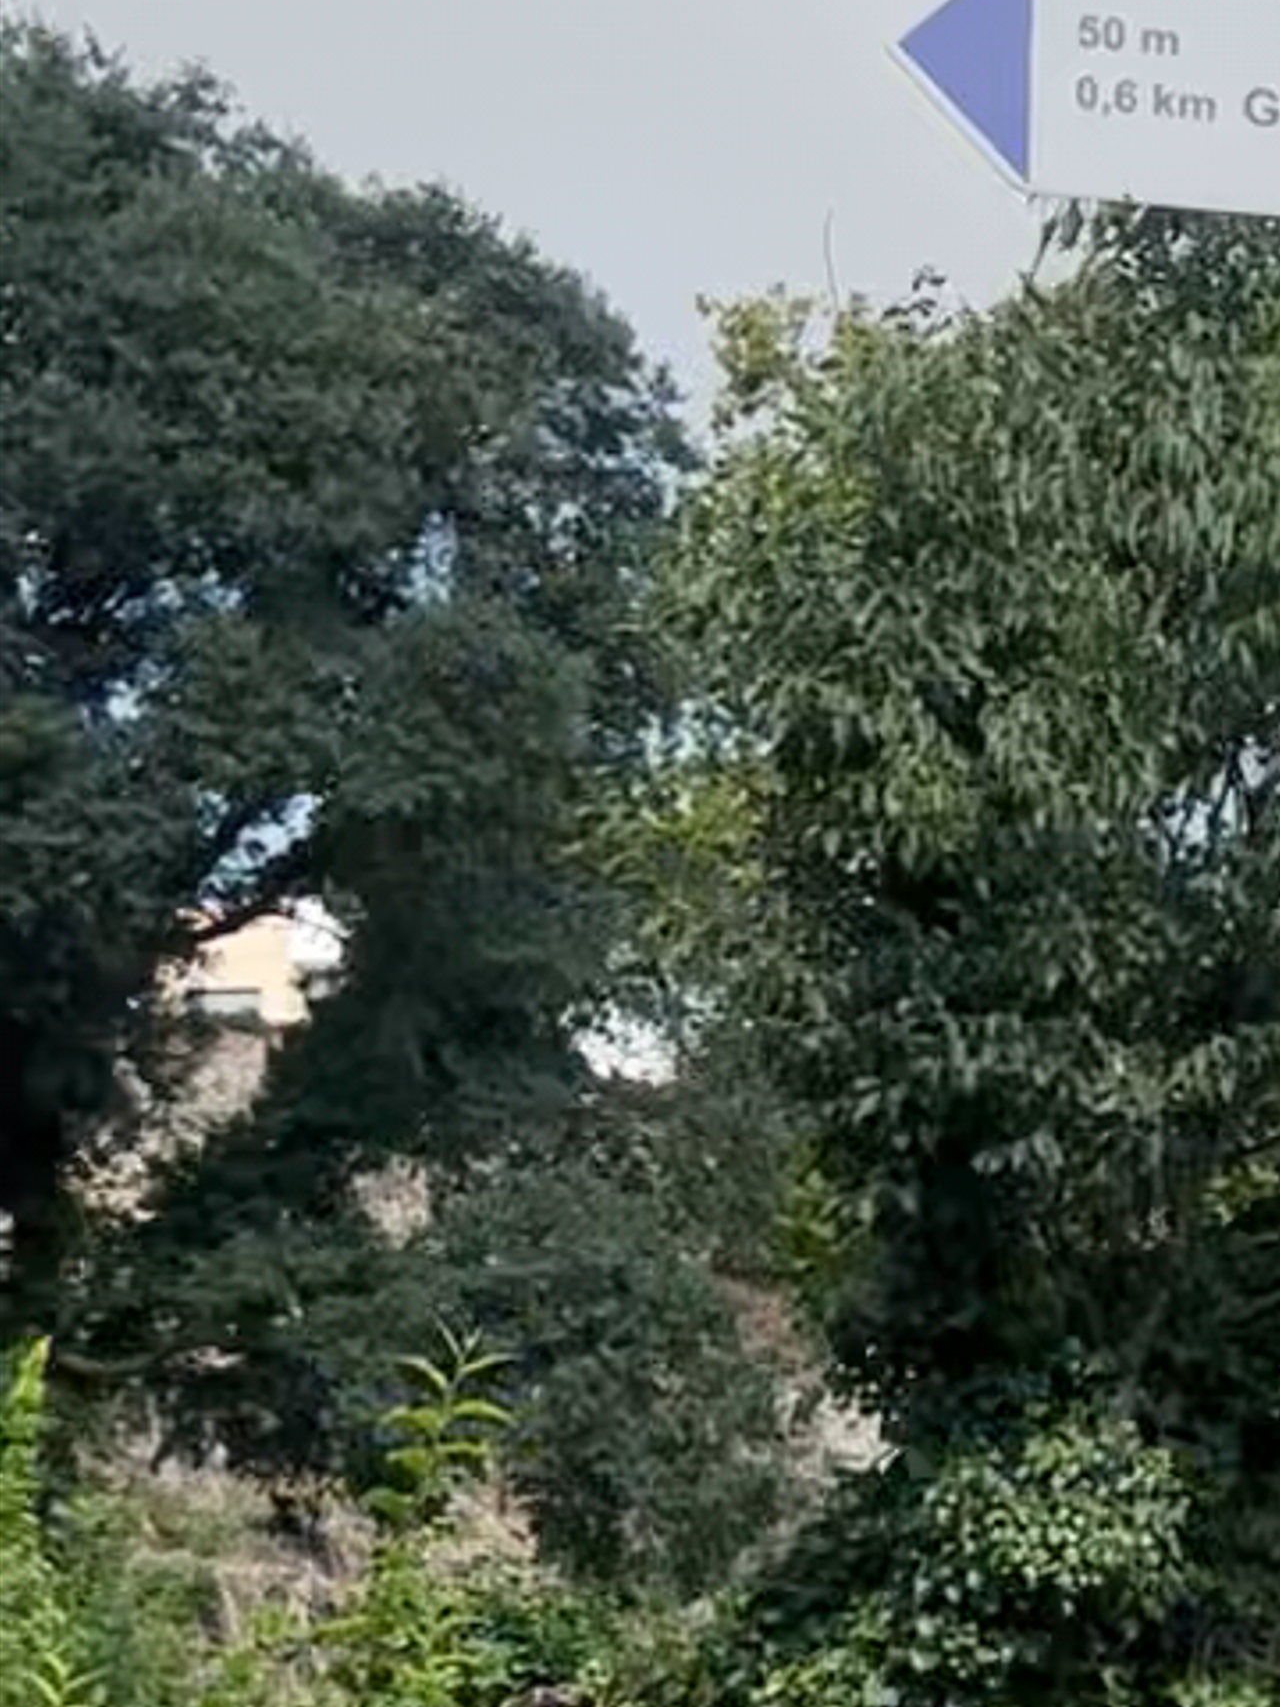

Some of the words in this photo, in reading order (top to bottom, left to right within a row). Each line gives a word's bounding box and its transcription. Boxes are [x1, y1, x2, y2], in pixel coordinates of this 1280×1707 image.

[1077, 13, 1127, 53] 50
[1139, 27, 1181, 58] m
[1074, 74, 1139, 118] 0,6
[1151, 82, 1218, 124] km
